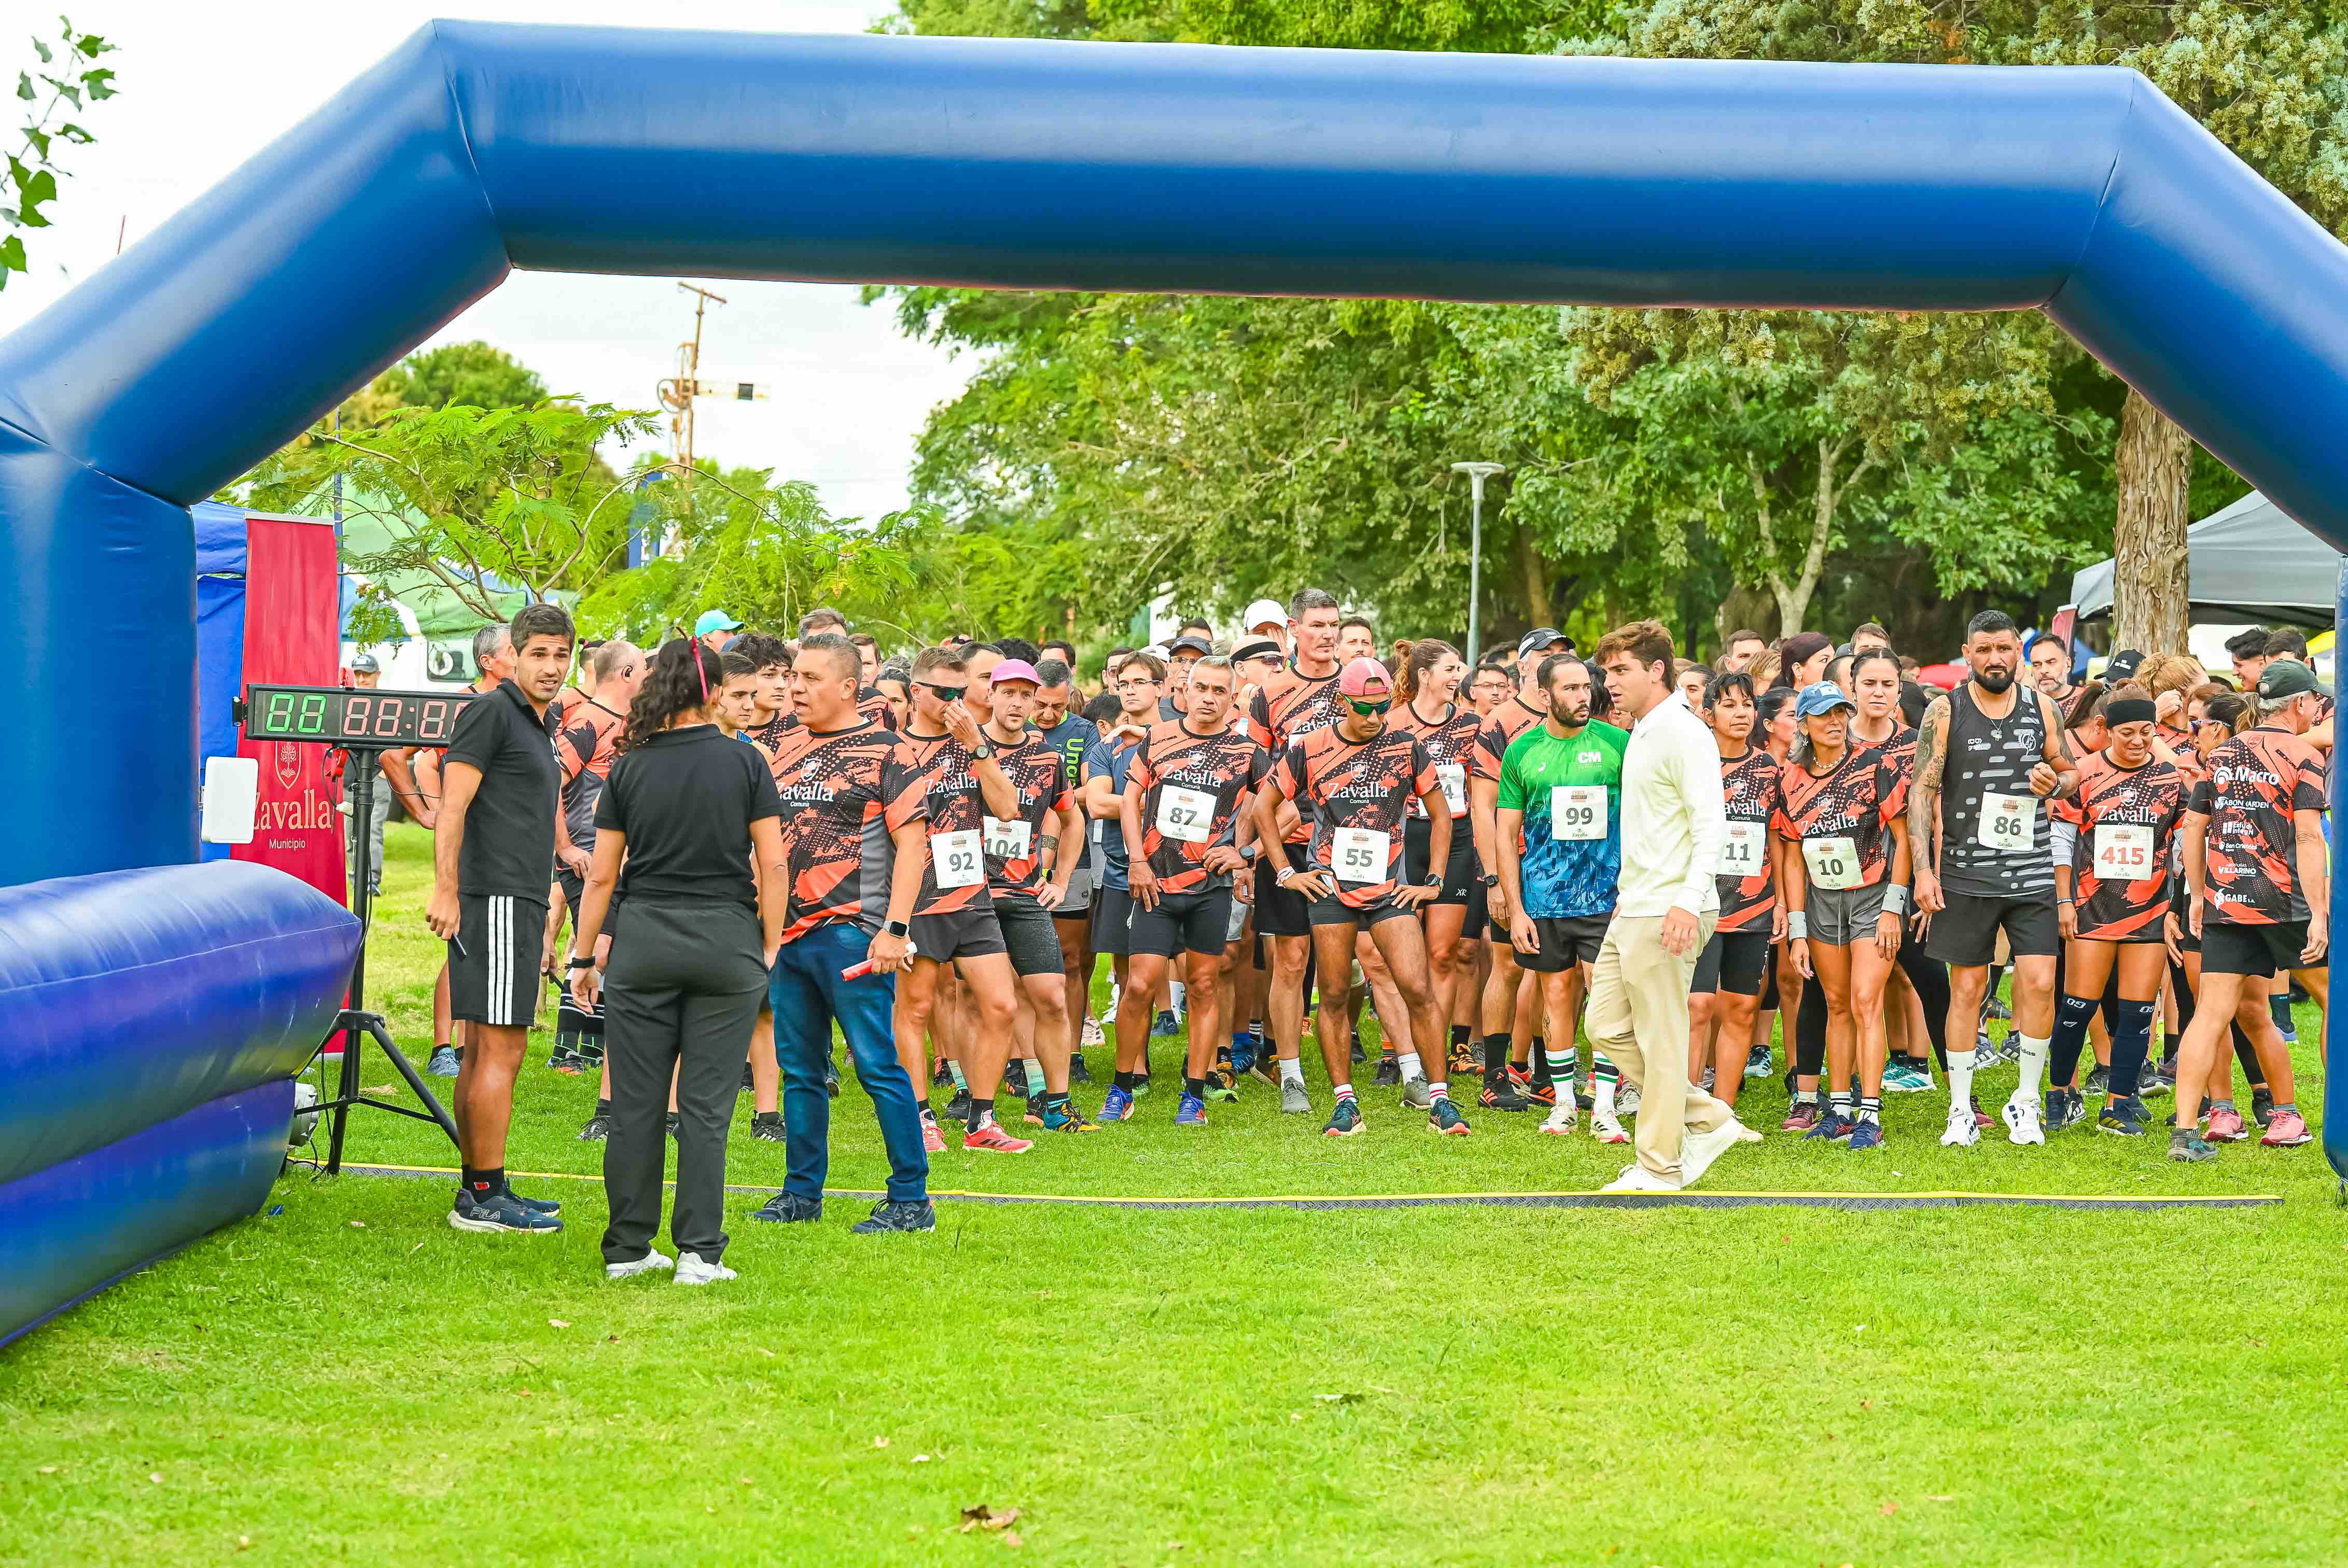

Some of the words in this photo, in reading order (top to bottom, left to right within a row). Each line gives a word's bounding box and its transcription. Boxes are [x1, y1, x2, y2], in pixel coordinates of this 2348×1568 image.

[1577, 751, 1602, 764] CM
[923, 772, 978, 795] Zavalla
[1161, 763, 1222, 788] Zavalla
[2235, 764, 2280, 785] Macro
[1327, 781, 1389, 799] Zavalla
[1170, 807, 1198, 825] 87
[1566, 807, 1593, 825] 99
[1725, 799, 1767, 817] avalla
[2097, 805, 2158, 824] Zavalla
[1801, 813, 1858, 836] Zavalla
[1994, 816, 2021, 836] 86
[269, 838, 306, 852] Municipio
[984, 838, 1021, 859] 104
[1725, 843, 1750, 861] 11
[949, 852, 974, 872] 92
[1346, 848, 1373, 867] 55
[2101, 846, 2144, 865] 415
[1818, 859, 1843, 875] 10
[2218, 866, 2257, 875] VILLARINO
[1456, 888, 1468, 897] XR
[2225, 894, 2247, 903] GABE
[470, 1206, 500, 1221] FILA
